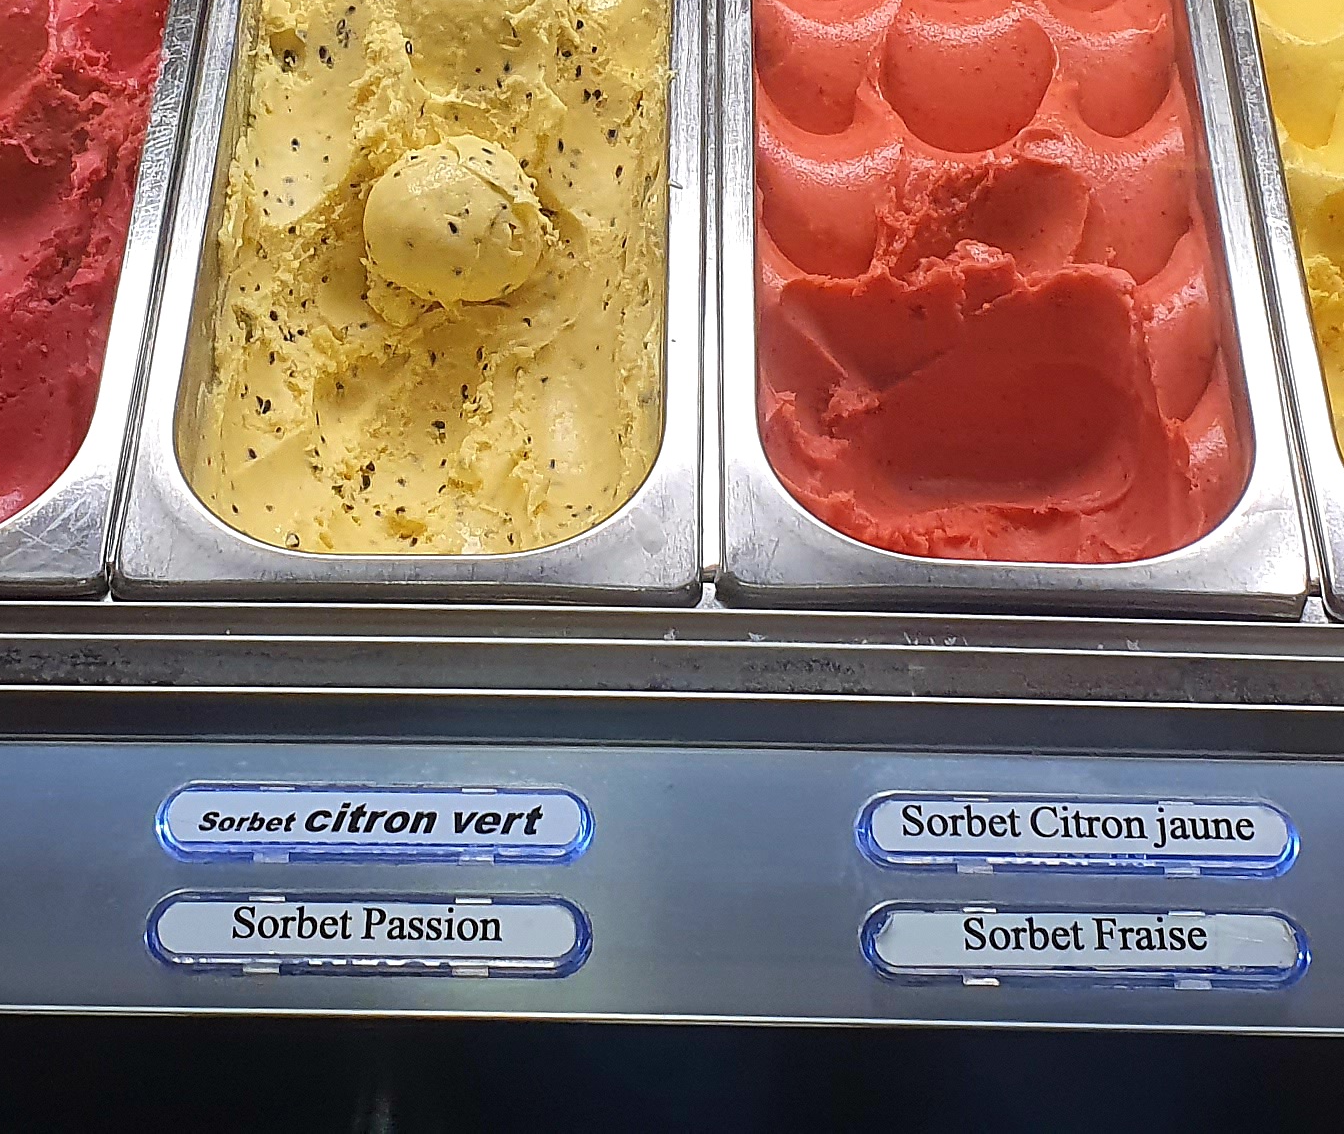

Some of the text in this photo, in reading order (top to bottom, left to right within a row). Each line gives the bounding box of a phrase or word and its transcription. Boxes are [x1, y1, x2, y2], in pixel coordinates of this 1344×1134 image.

[198, 802, 544, 835] Sorbet citron vert
[902, 805, 1256, 848] Sorbet Citron jaune
[232, 907, 503, 942] Sorbet Passion
[963, 917, 1208, 951] Sorbet Fraise
